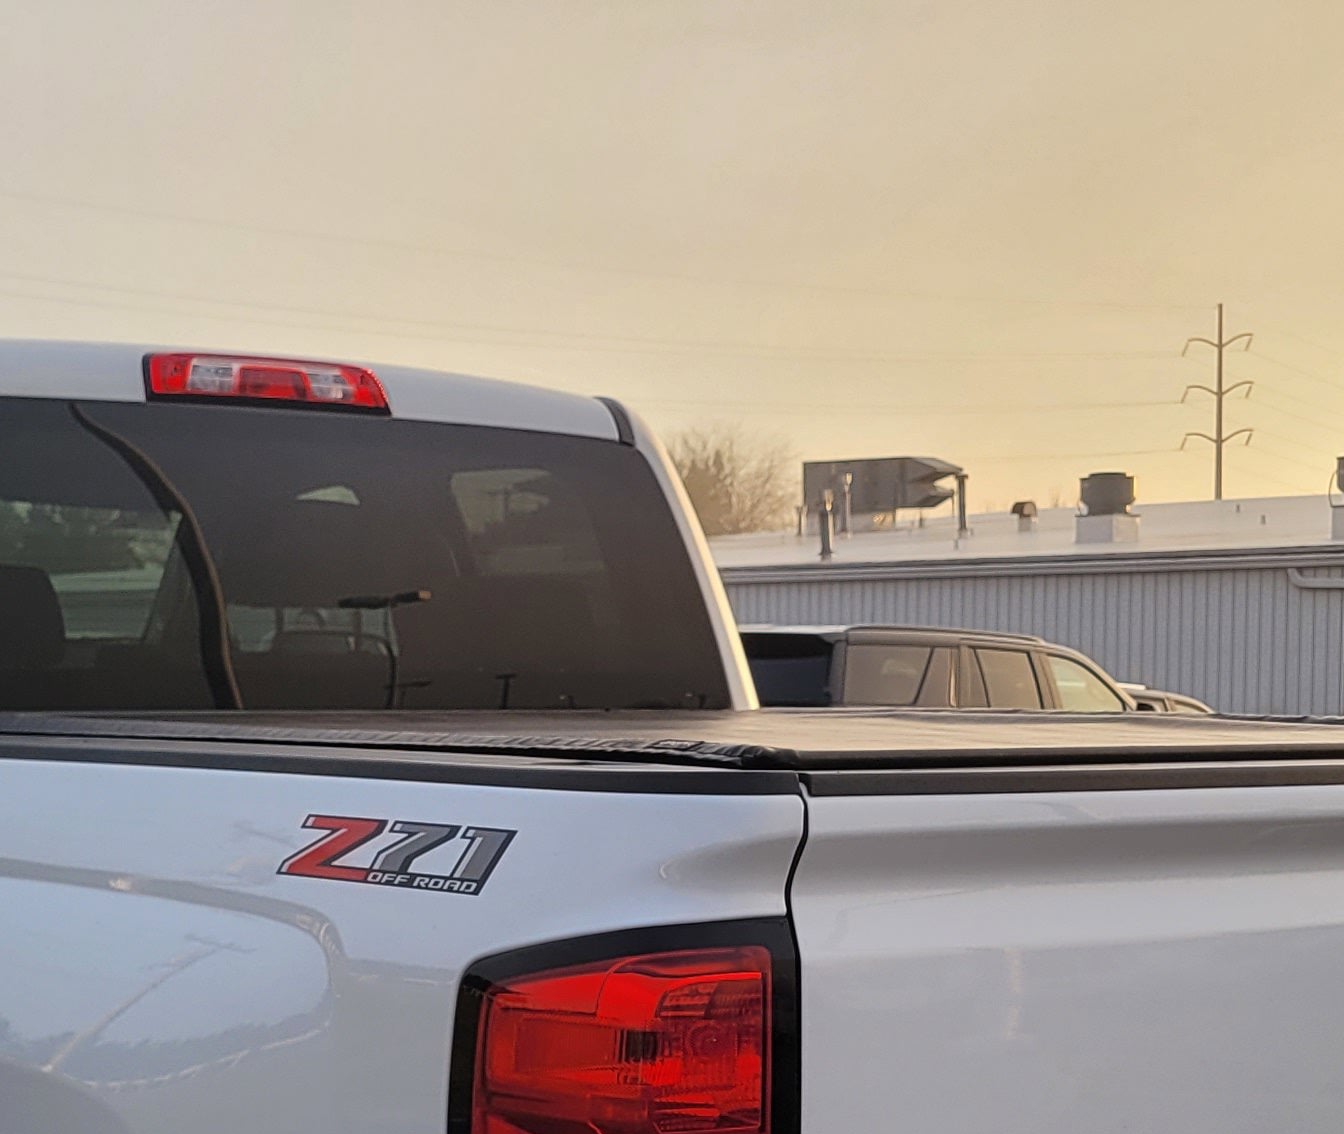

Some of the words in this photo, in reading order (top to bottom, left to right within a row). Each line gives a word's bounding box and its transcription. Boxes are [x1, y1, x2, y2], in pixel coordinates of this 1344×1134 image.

[276, 813, 518, 884] Z71
[367, 871, 411, 885] OFF
[412, 876, 478, 893] ROAD
